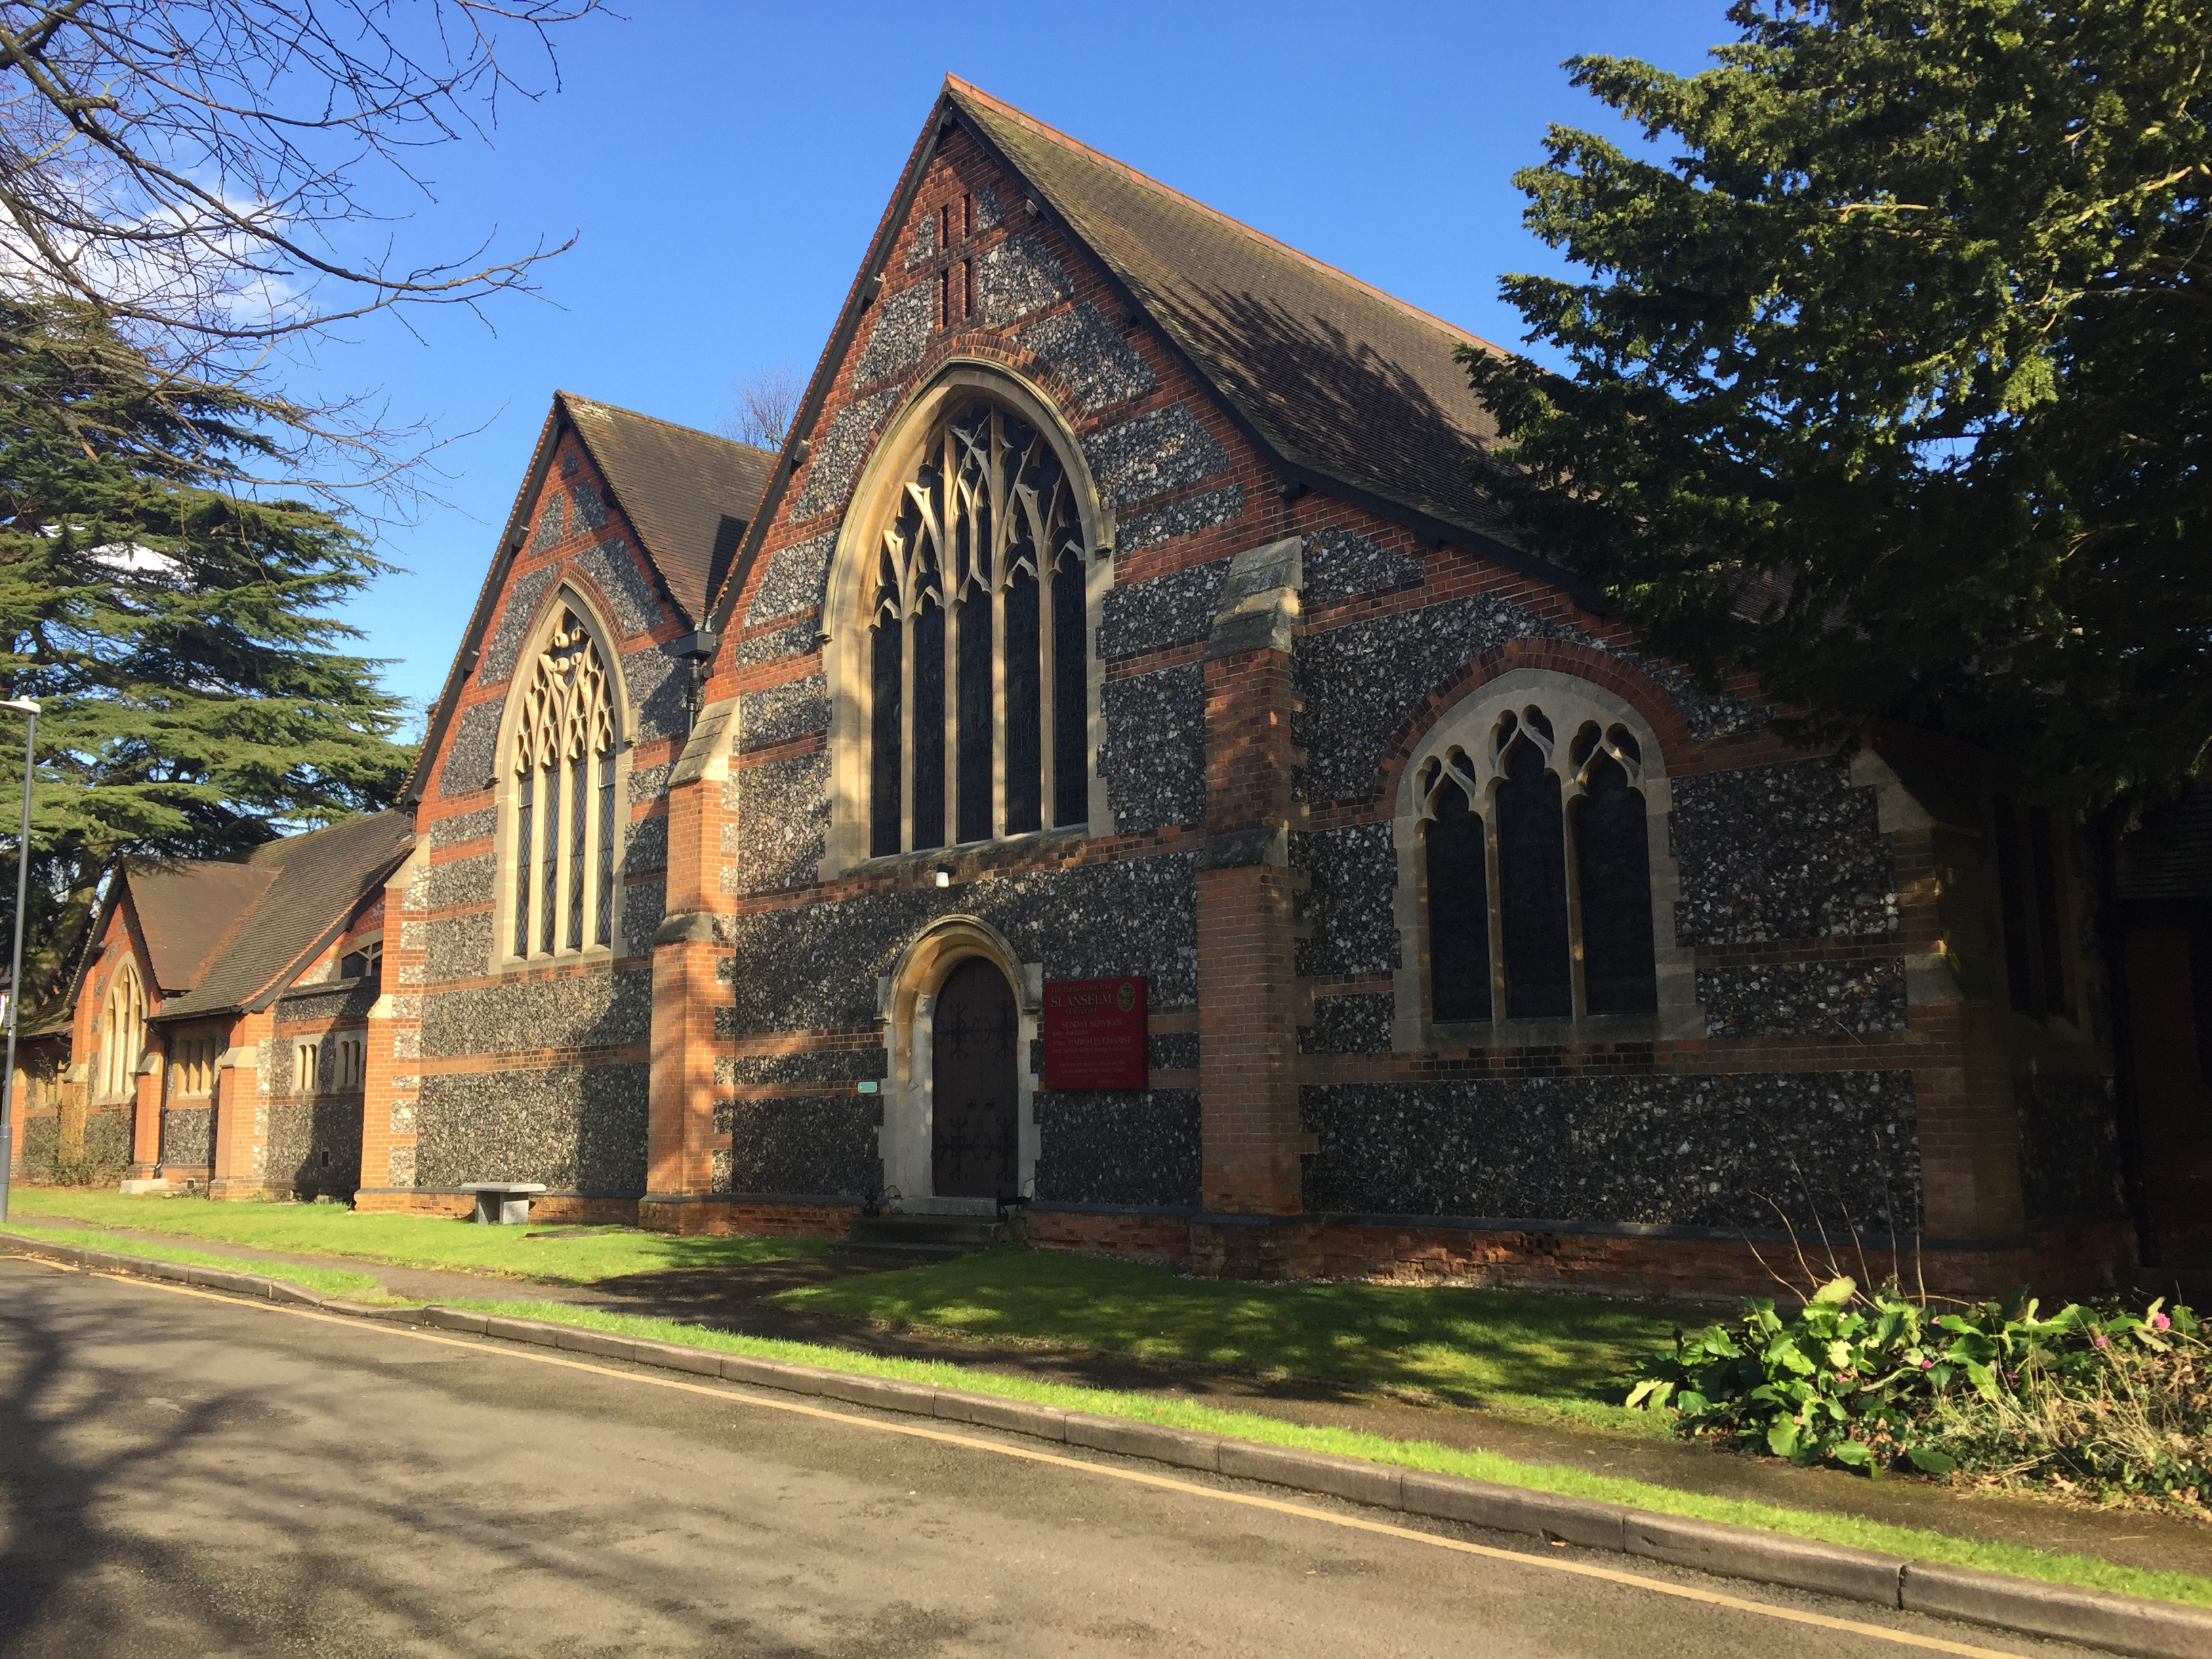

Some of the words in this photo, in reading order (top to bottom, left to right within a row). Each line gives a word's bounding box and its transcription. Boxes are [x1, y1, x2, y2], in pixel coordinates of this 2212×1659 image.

[1065, 994, 1112, 1006] ANSELM
[1061, 1020, 1088, 1028] SUNDAY
[1089, 1018, 1122, 1027] SERVICES
[1068, 1037, 1092, 1046] PARISH
[1093, 1036, 1132, 1045] EUCHARIST
